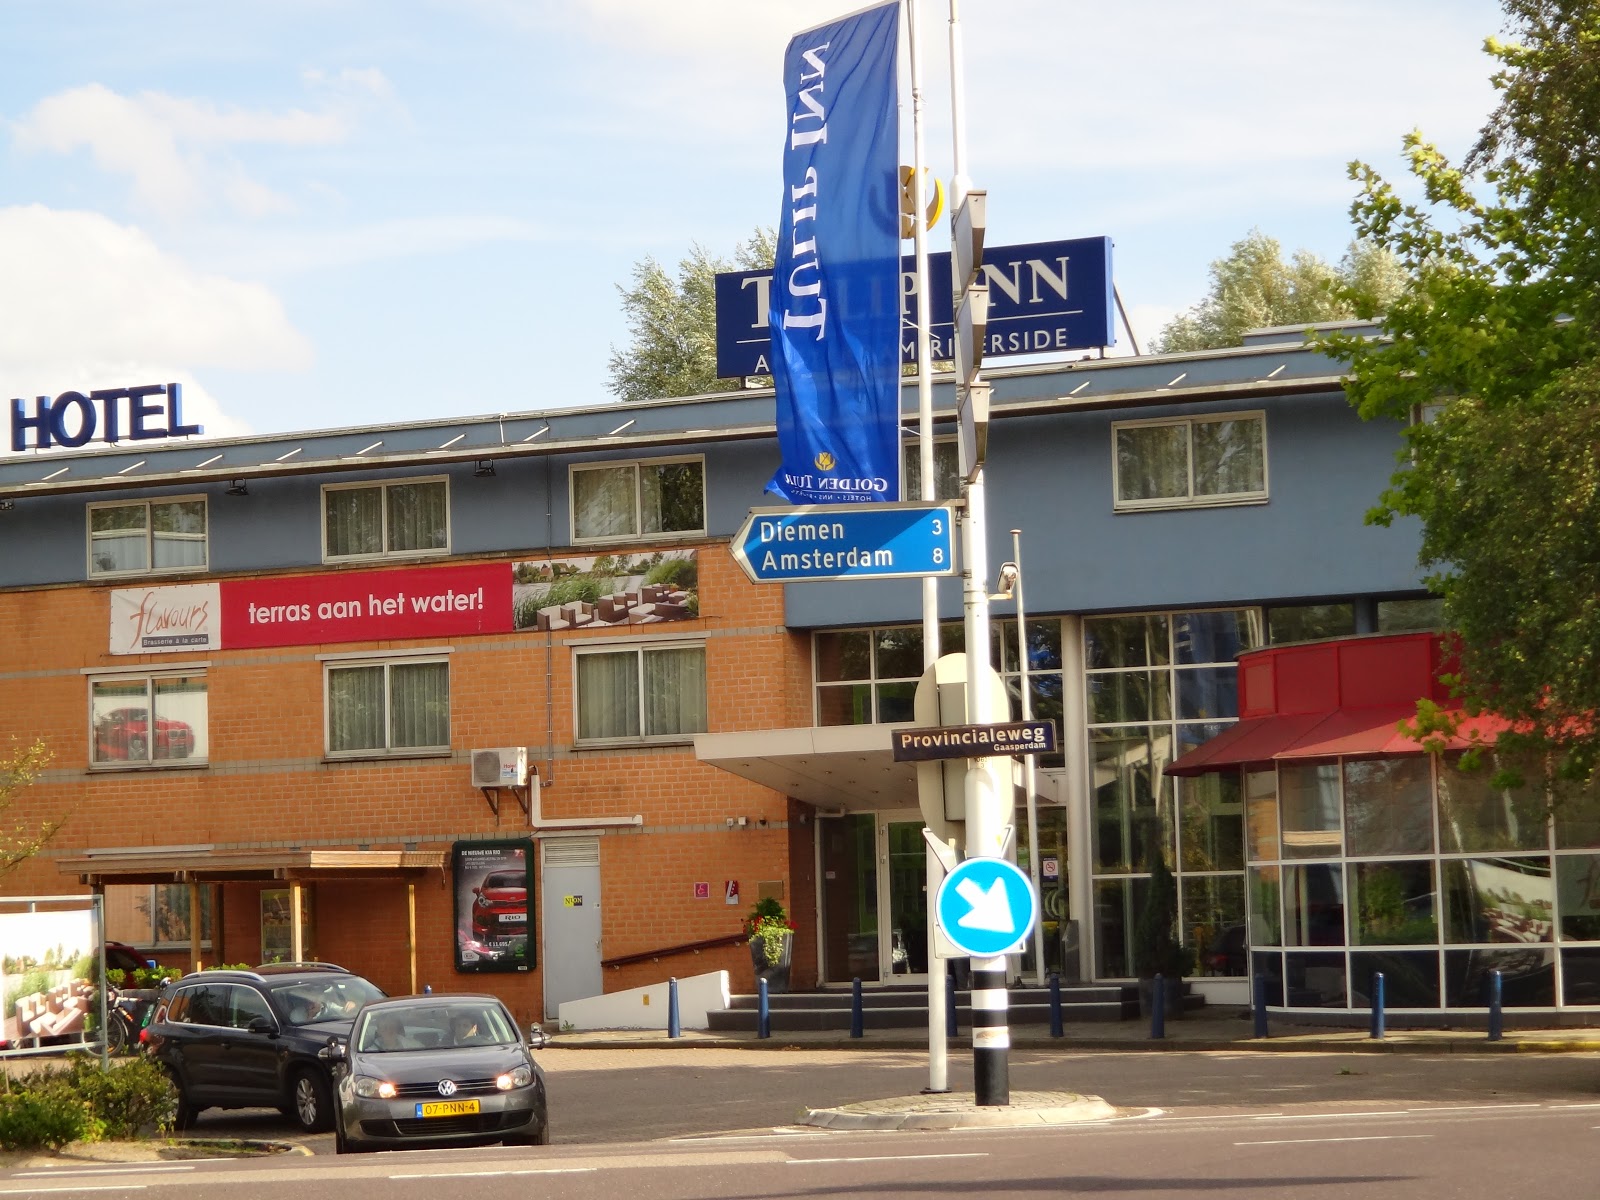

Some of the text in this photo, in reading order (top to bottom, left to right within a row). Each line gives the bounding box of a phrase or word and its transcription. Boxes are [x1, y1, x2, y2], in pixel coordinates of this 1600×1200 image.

[980, 256, 1070, 307] NN
[930, 328, 1067, 358] RIRSIDE
[10, 382, 204, 452] HOTEL
[760, 519, 942, 543] Diemen 3
[762, 547, 943, 571] Amsterdam 8
[249, 587, 484, 624] terras aan het water!
[143, 638, 173, 646] Brasserie
[901, 727, 1045, 748] Provincialeweg
[993, 742, 1046, 752] Gaasperdam
[425, 1102, 475, 1115] 07-PNN-4
